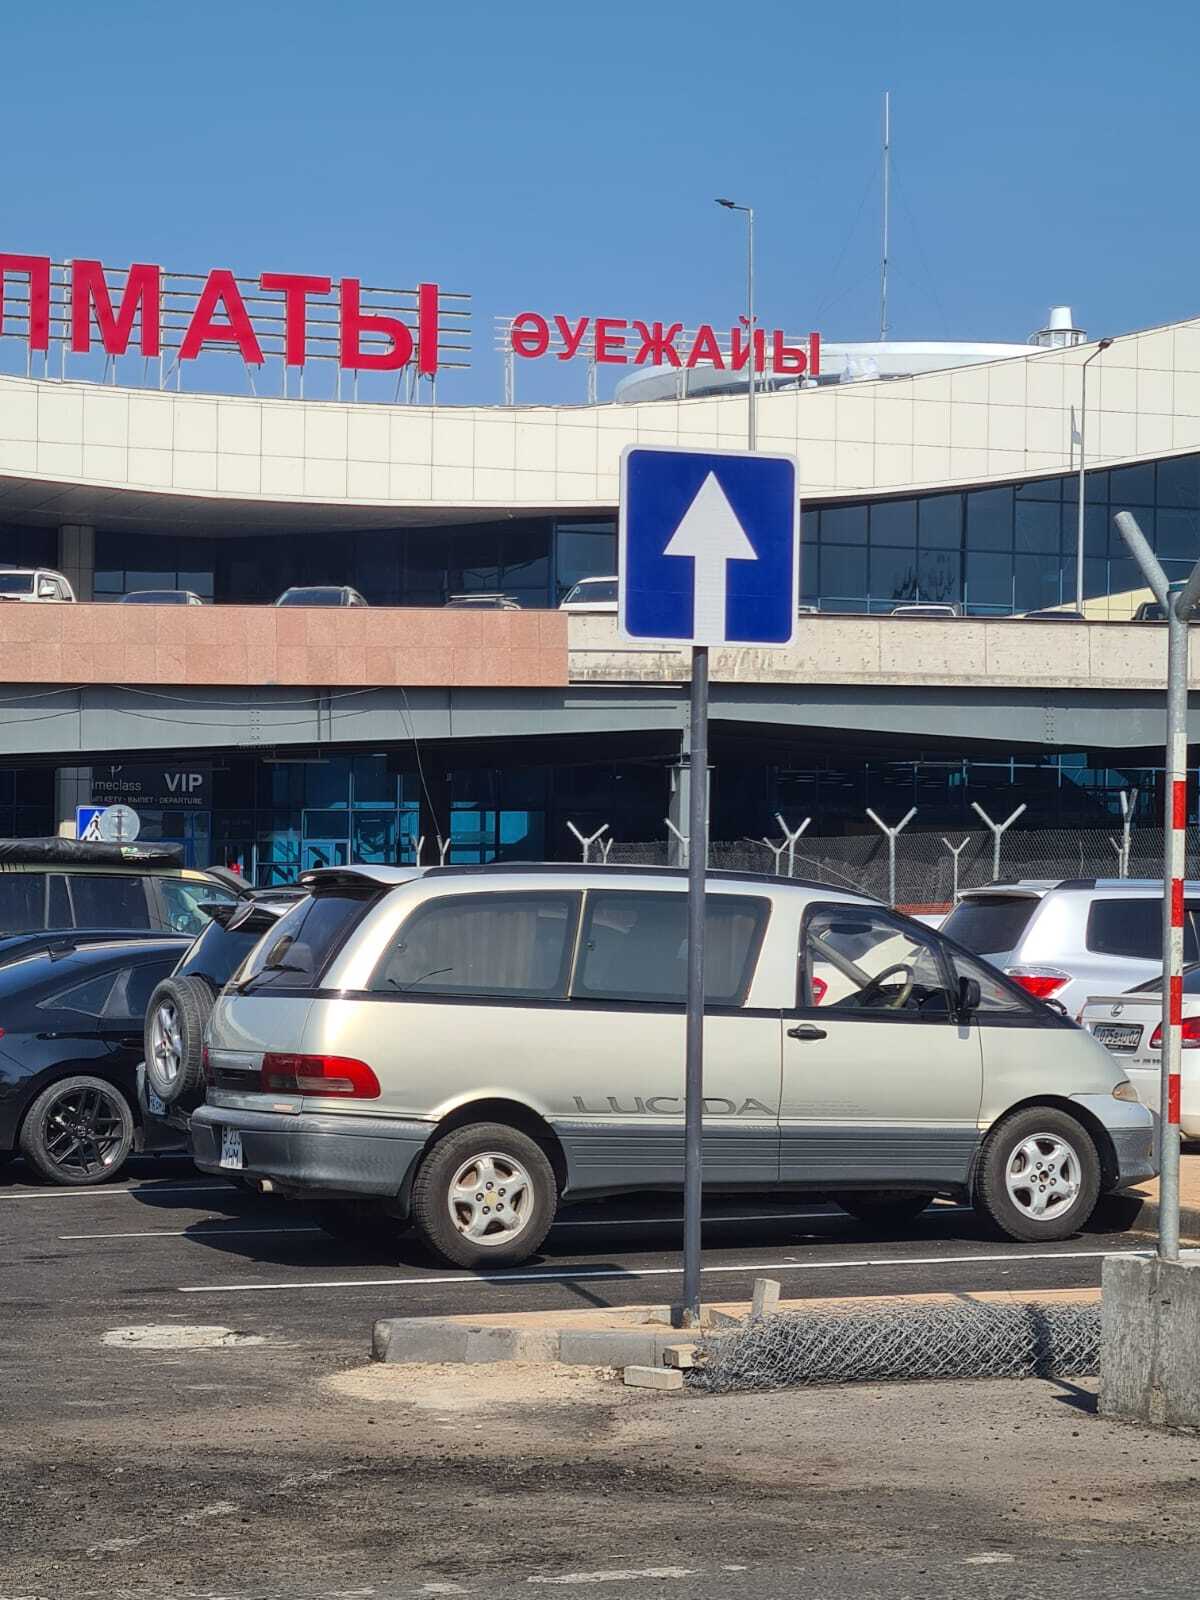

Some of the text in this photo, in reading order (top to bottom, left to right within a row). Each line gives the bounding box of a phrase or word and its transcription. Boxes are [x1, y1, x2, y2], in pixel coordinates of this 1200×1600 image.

[511, 312, 820, 376] ӘУЕЖАЙЫ
[164, 773, 203, 793] VIP
[573, 1096, 778, 1116] LUCDA
